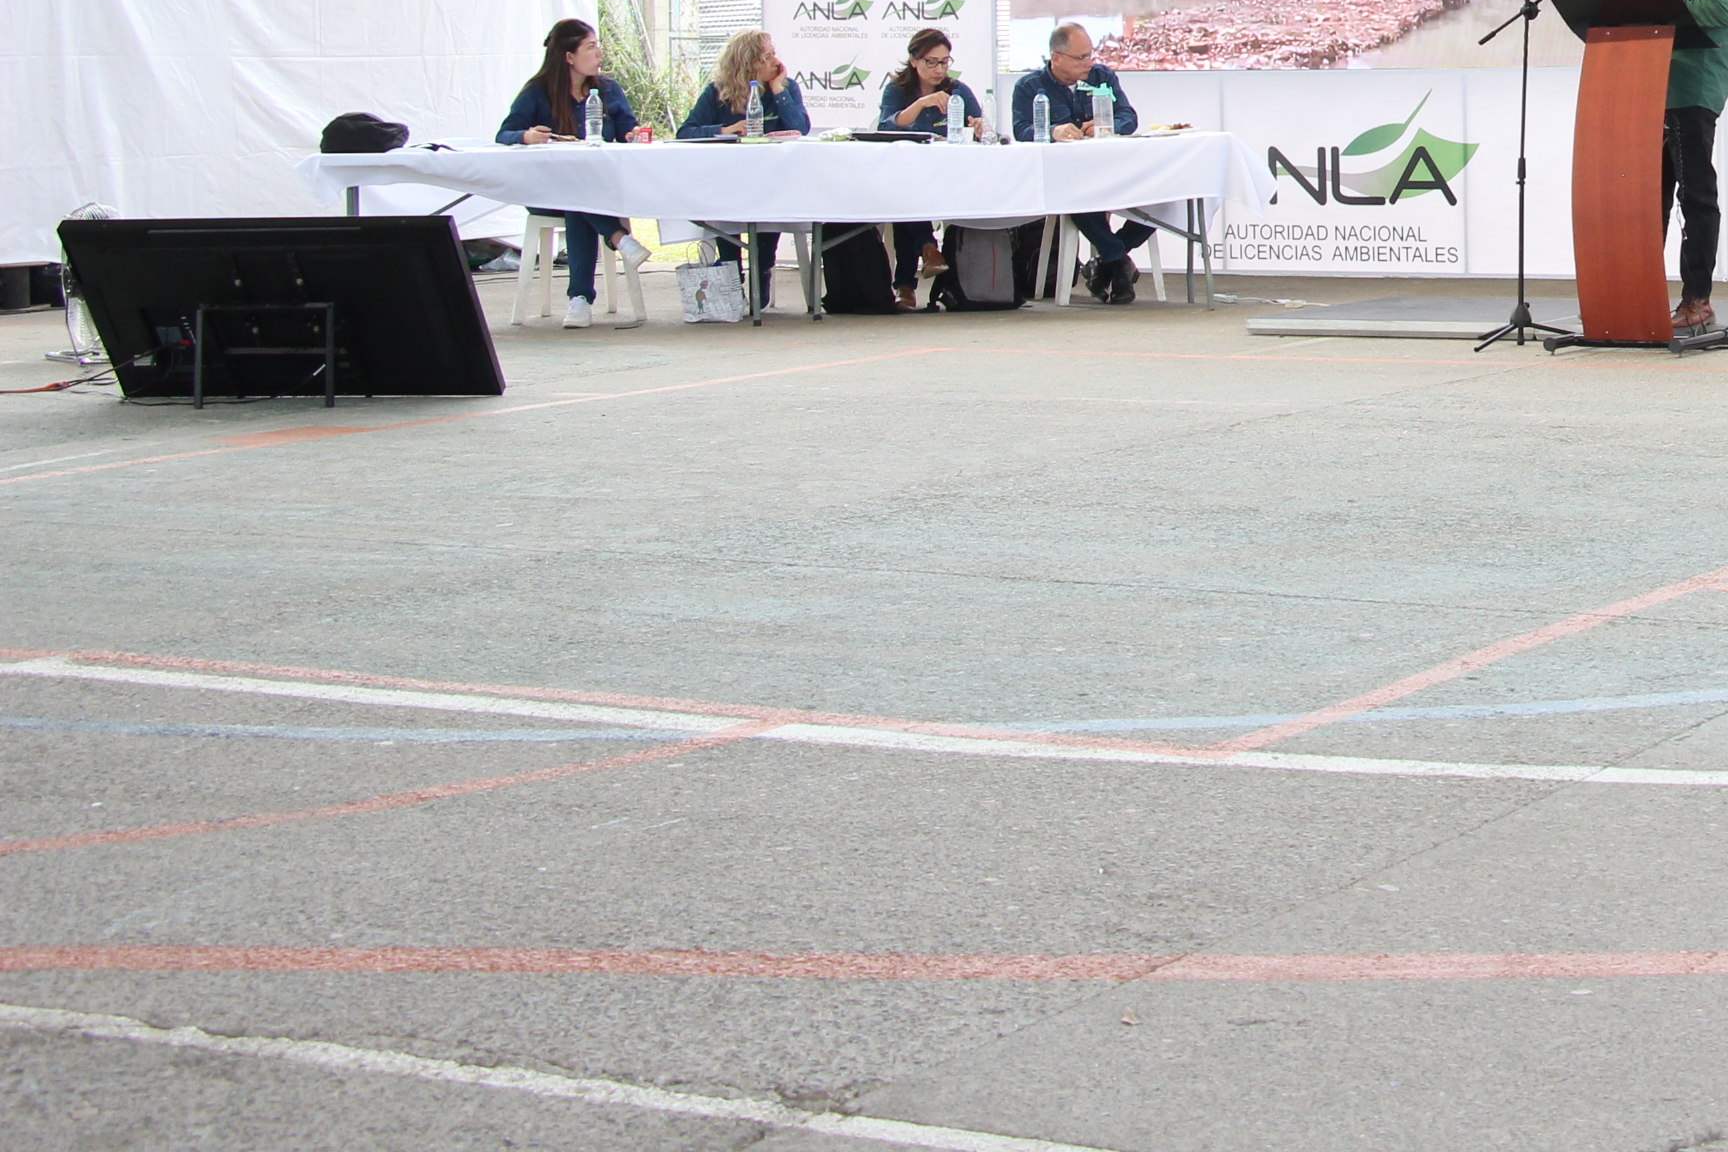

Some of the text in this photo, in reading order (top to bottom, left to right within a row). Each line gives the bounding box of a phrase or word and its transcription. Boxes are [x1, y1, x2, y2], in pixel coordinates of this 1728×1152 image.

[792, 0, 868, 20] ANLA
[881, 0, 959, 20] ANLA
[827, 101, 866, 109] AMBIENTALES
[1268, 145, 1458, 207] NLA
[1224, 224, 1428, 242] AUTORIDAD NACIONAL
[1230, 243, 1322, 261] LICENCIAS
[1331, 245, 1461, 264] AMBIENTALES
